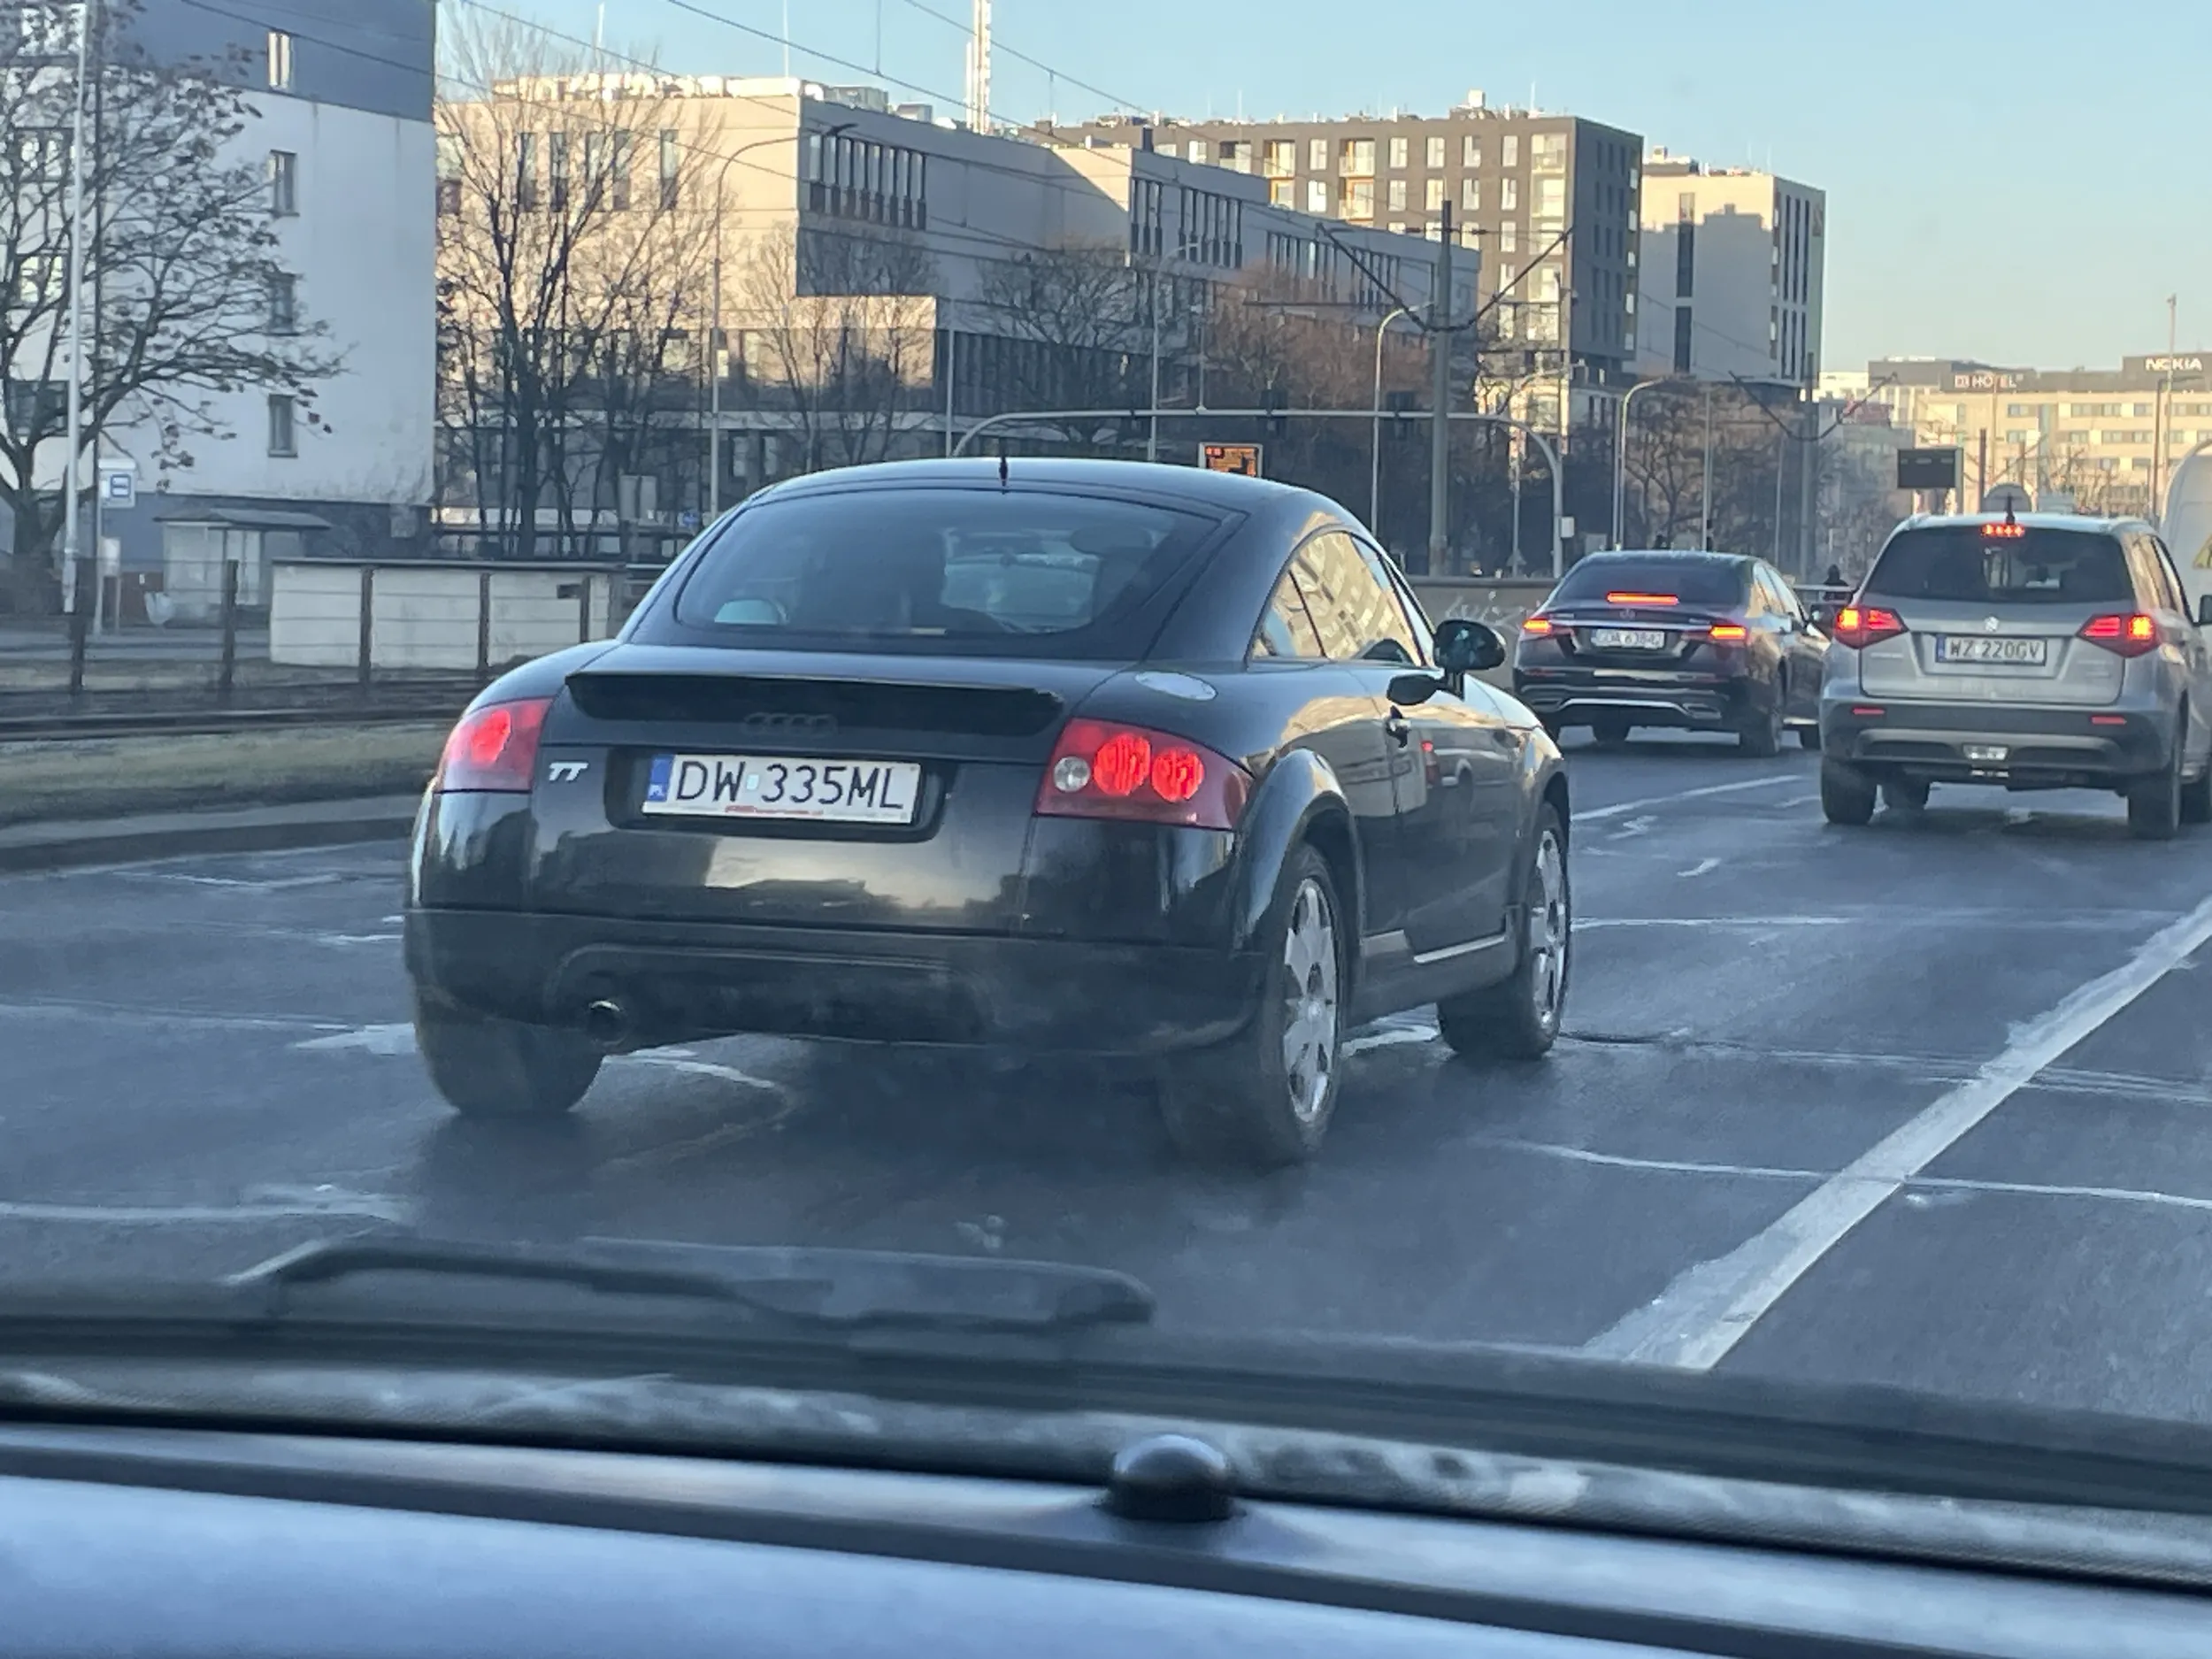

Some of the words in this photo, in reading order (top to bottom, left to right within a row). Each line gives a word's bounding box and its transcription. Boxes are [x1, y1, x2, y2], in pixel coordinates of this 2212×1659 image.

[2145, 357, 2202, 372] NOKIA
[1950, 639, 1974, 657] WZ
[1982, 640, 2039, 659] 220GV
[549, 762, 589, 780] TT
[676, 761, 746, 802] DW
[761, 764, 903, 810] 335ML
